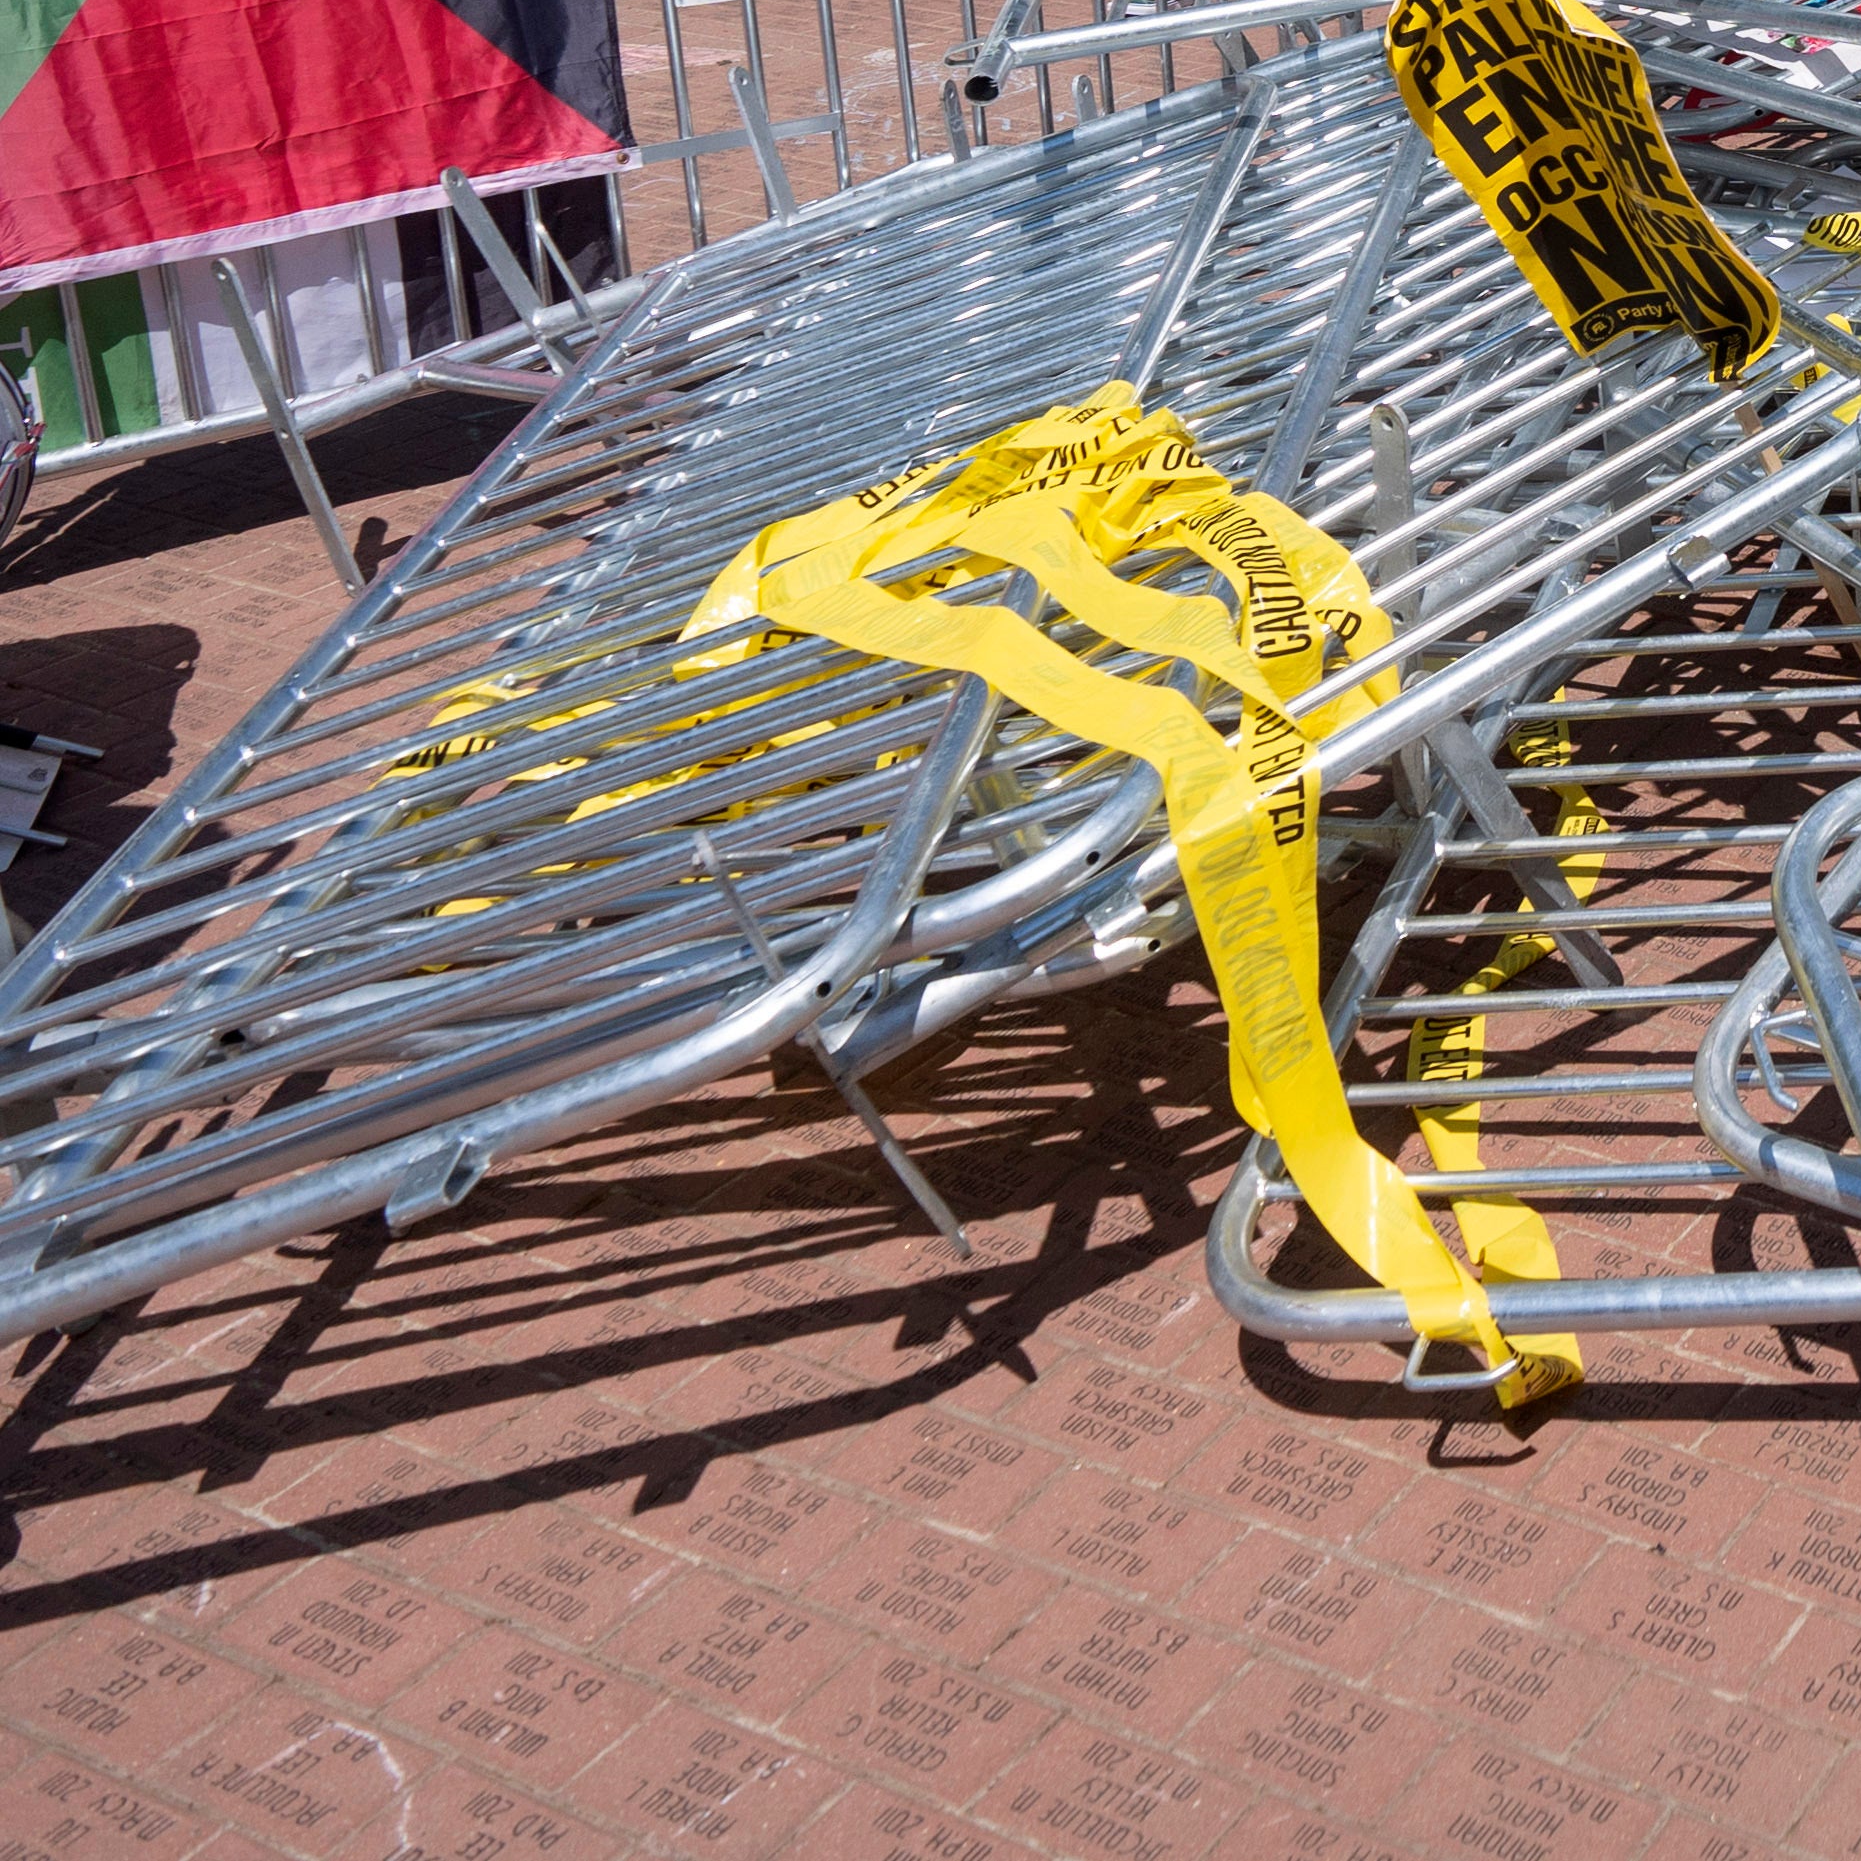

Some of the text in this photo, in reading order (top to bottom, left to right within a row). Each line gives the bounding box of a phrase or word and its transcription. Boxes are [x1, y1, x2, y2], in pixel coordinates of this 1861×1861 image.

[1060, 1412, 1139, 1452] ALLISON
[1620, 1445, 1664, 1472] 2011
[1251, 1485, 1326, 1522] STEVEN
[1604, 1467, 1687, 1507] GORDON
[1092, 1514, 1149, 1543] HOFF
[1597, 1493, 1688, 1535] LINDSAY
[701, 1622, 767, 1661] KATZ
[1627, 1618, 1717, 1662] GILBERT
[96, 1669, 149, 1701] LEE
[683, 1650, 758, 1695] DANIEL
